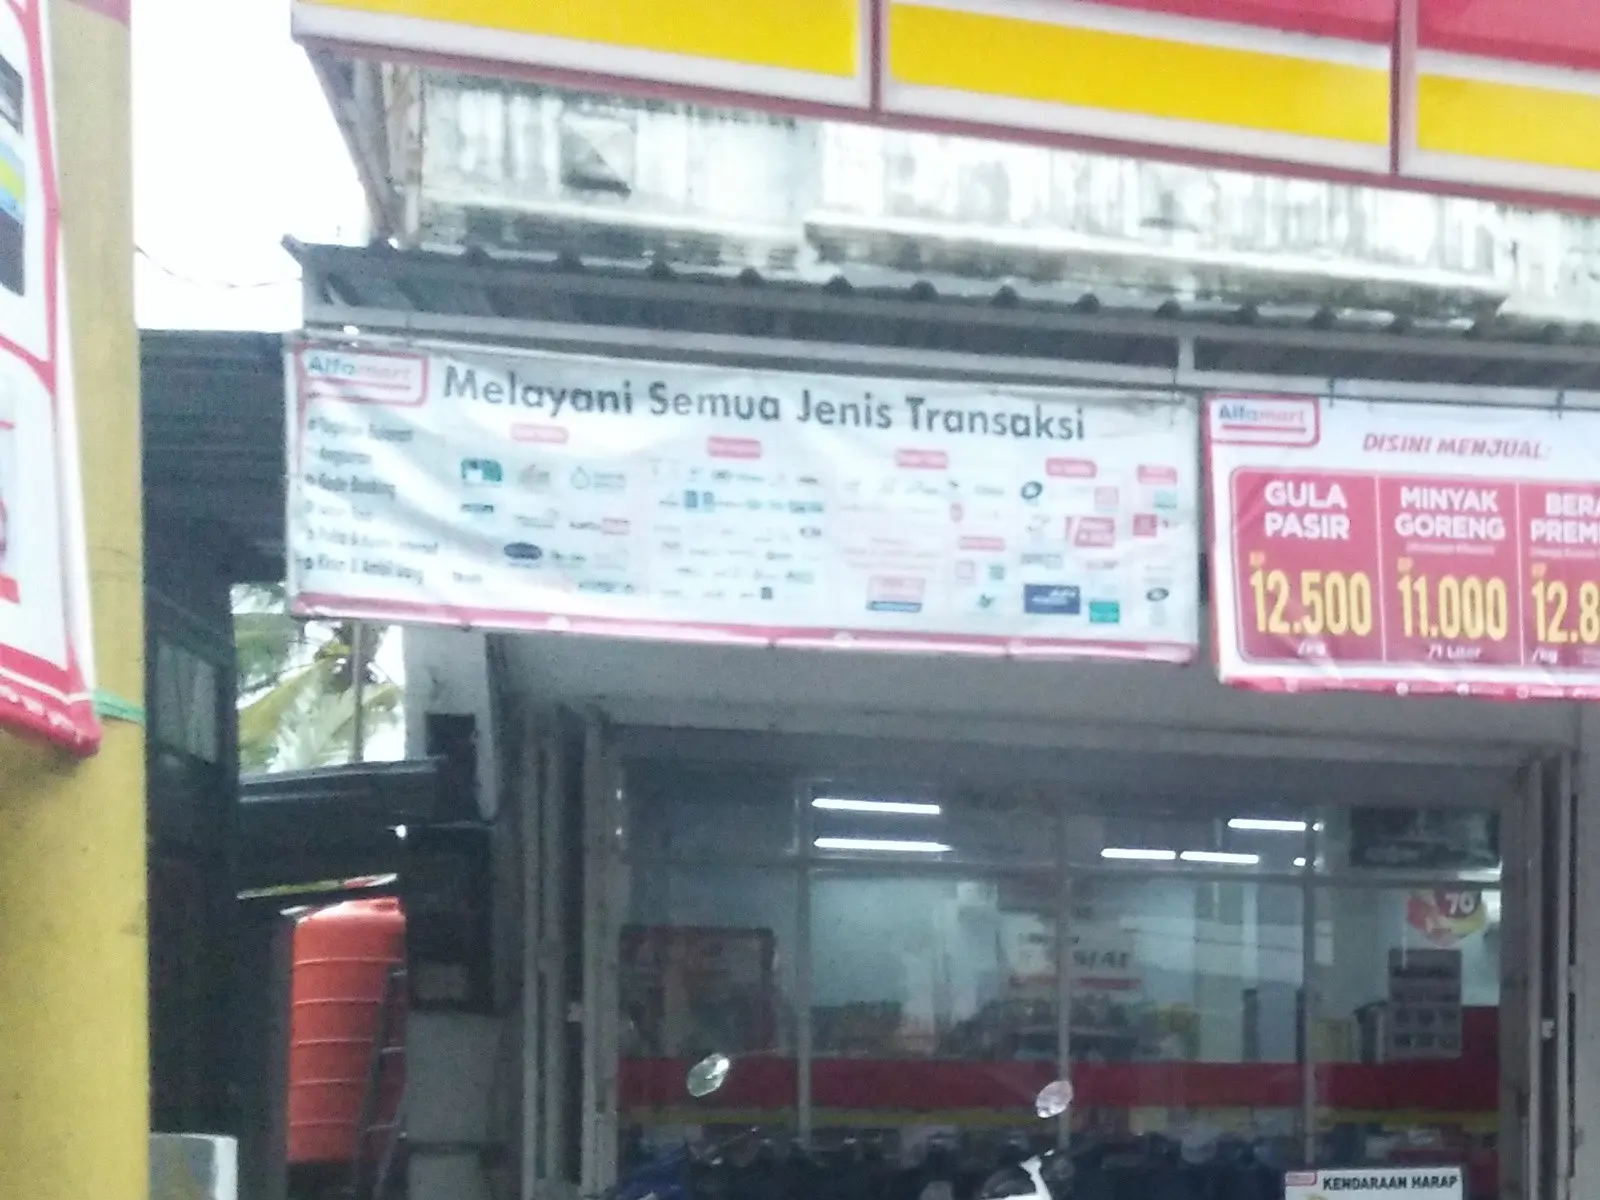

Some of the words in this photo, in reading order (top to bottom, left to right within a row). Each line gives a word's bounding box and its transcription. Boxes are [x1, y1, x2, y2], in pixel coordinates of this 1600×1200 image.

[444, 366, 634, 417] Melayani
[649, 382, 781, 421] Semua
[797, 389, 893, 429] Jenis
[905, 397, 1085, 440] Transaksi
[1363, 434, 1431, 456] DISINI
[1264, 481, 1348, 510] GULA
[1401, 486, 1499, 513] MINYAK
[1264, 512, 1350, 540] PASIR
[1394, 512, 1506, 540] GORENG
[1250, 569, 1372, 635] 12.500
[1397, 575, 1508, 640] 11.000
[1323, 1176, 1407, 1191] KENDARAAN
[1411, 1175, 1458, 1190] HARAP
